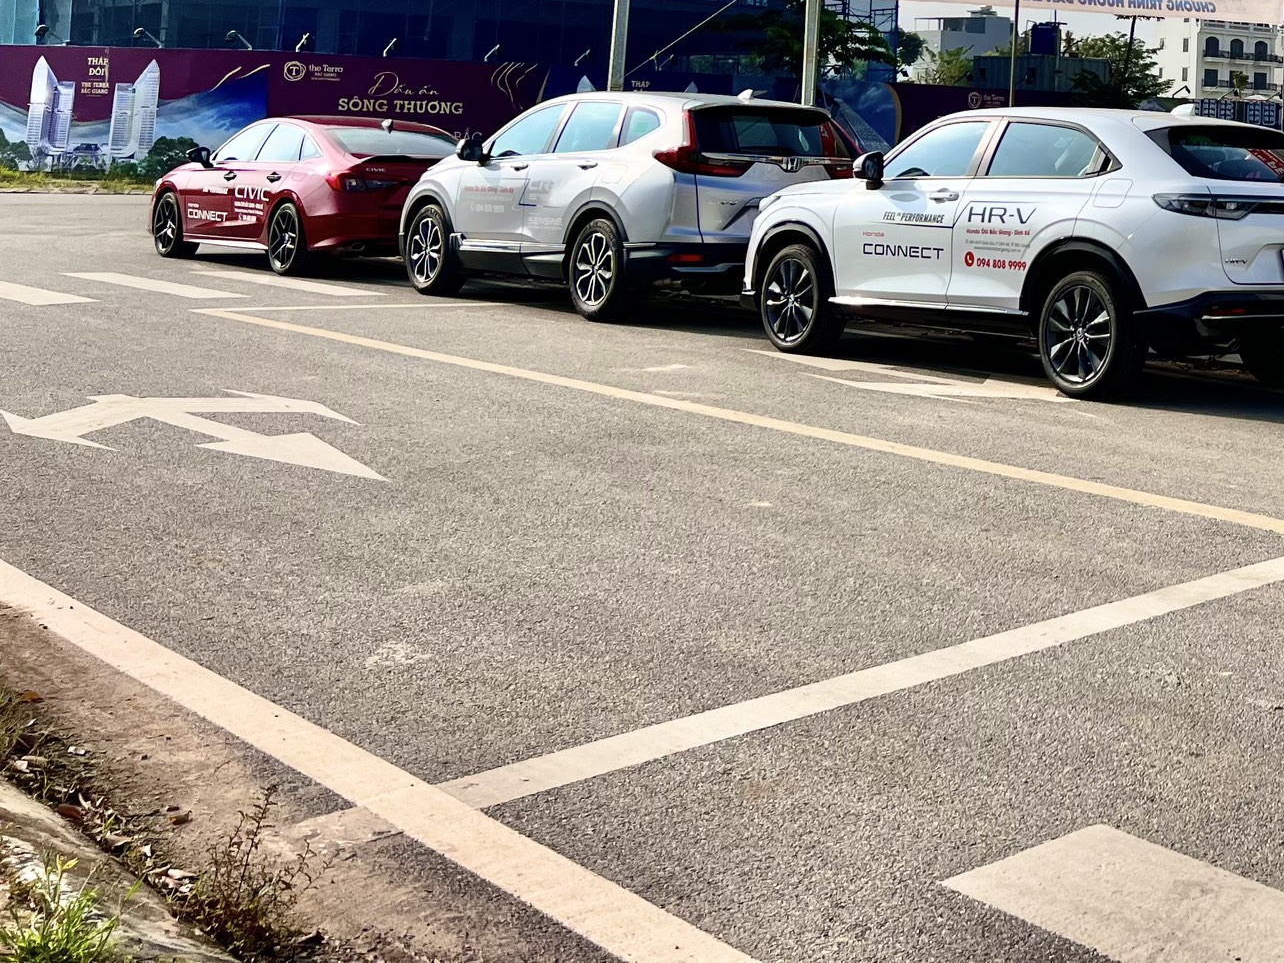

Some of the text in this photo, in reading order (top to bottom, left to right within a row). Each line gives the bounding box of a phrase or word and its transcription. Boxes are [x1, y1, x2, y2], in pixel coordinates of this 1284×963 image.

[338, 96, 463, 114] SÔNG THƯƠNG
[234, 184, 270, 201] CIVIC
[187, 209, 228, 221] CONNECT
[883, 211, 896, 221] FEEL
[900, 212, 945, 224] PERFORMANCE
[968, 206, 1037, 224] HR-V
[863, 243, 944, 260] CONNECT
[976, 258, 1027, 271] 094 808 9999
